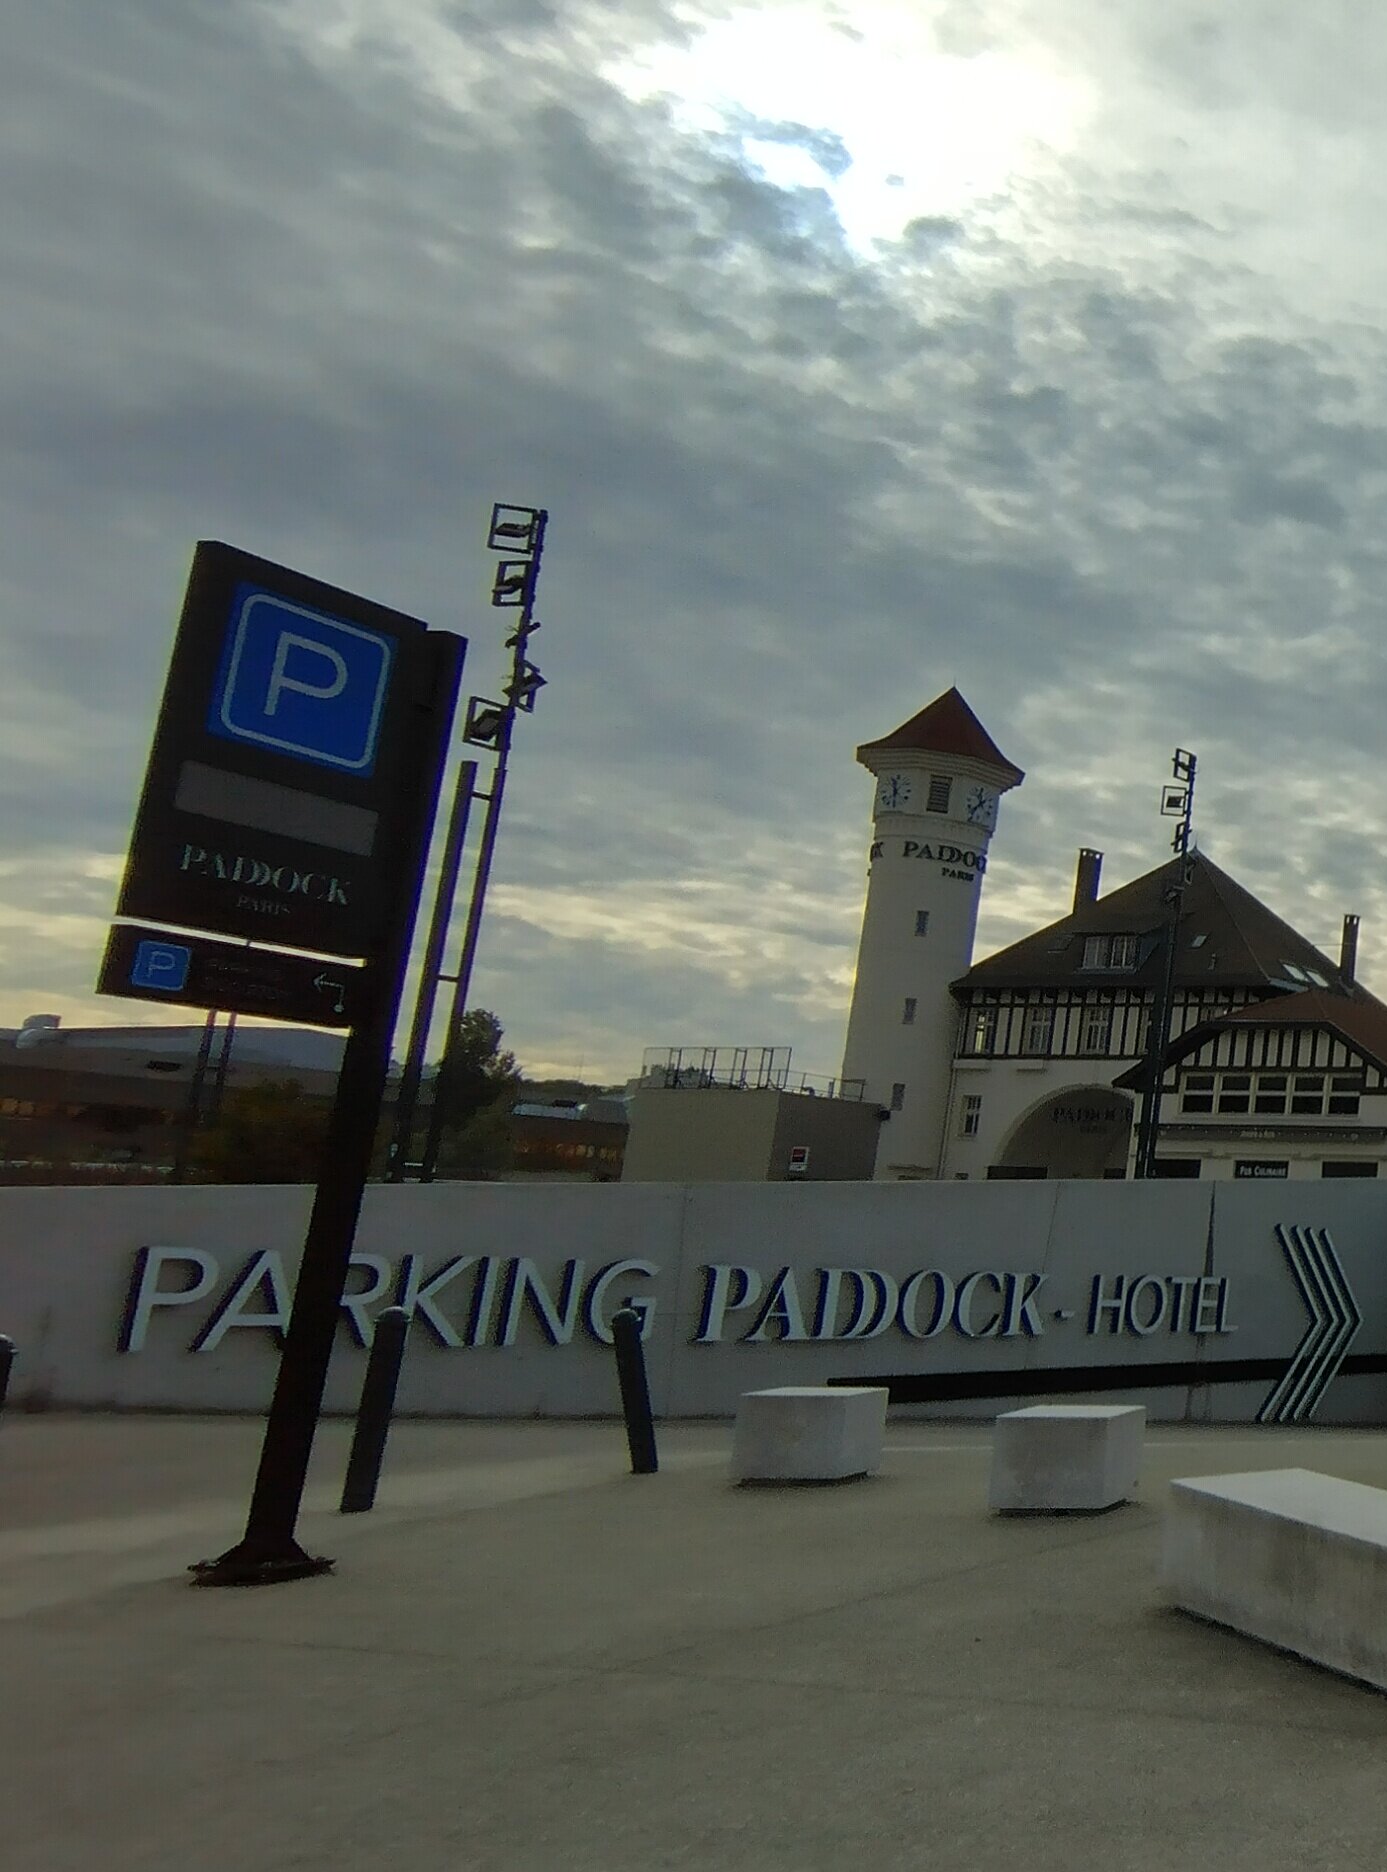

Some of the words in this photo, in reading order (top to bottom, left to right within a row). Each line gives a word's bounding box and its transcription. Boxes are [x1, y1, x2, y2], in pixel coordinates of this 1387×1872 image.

[263, 631, 348, 716] P
[180, 842, 352, 906] PADDOCK
[235, 894, 292, 915] PARIS
[146, 950, 176, 979] P
[117, 1246, 660, 1353] PARKING
[690, 1264, 1048, 1343] PADDOCK
[1087, 1273, 1239, 1334] HOTEL
